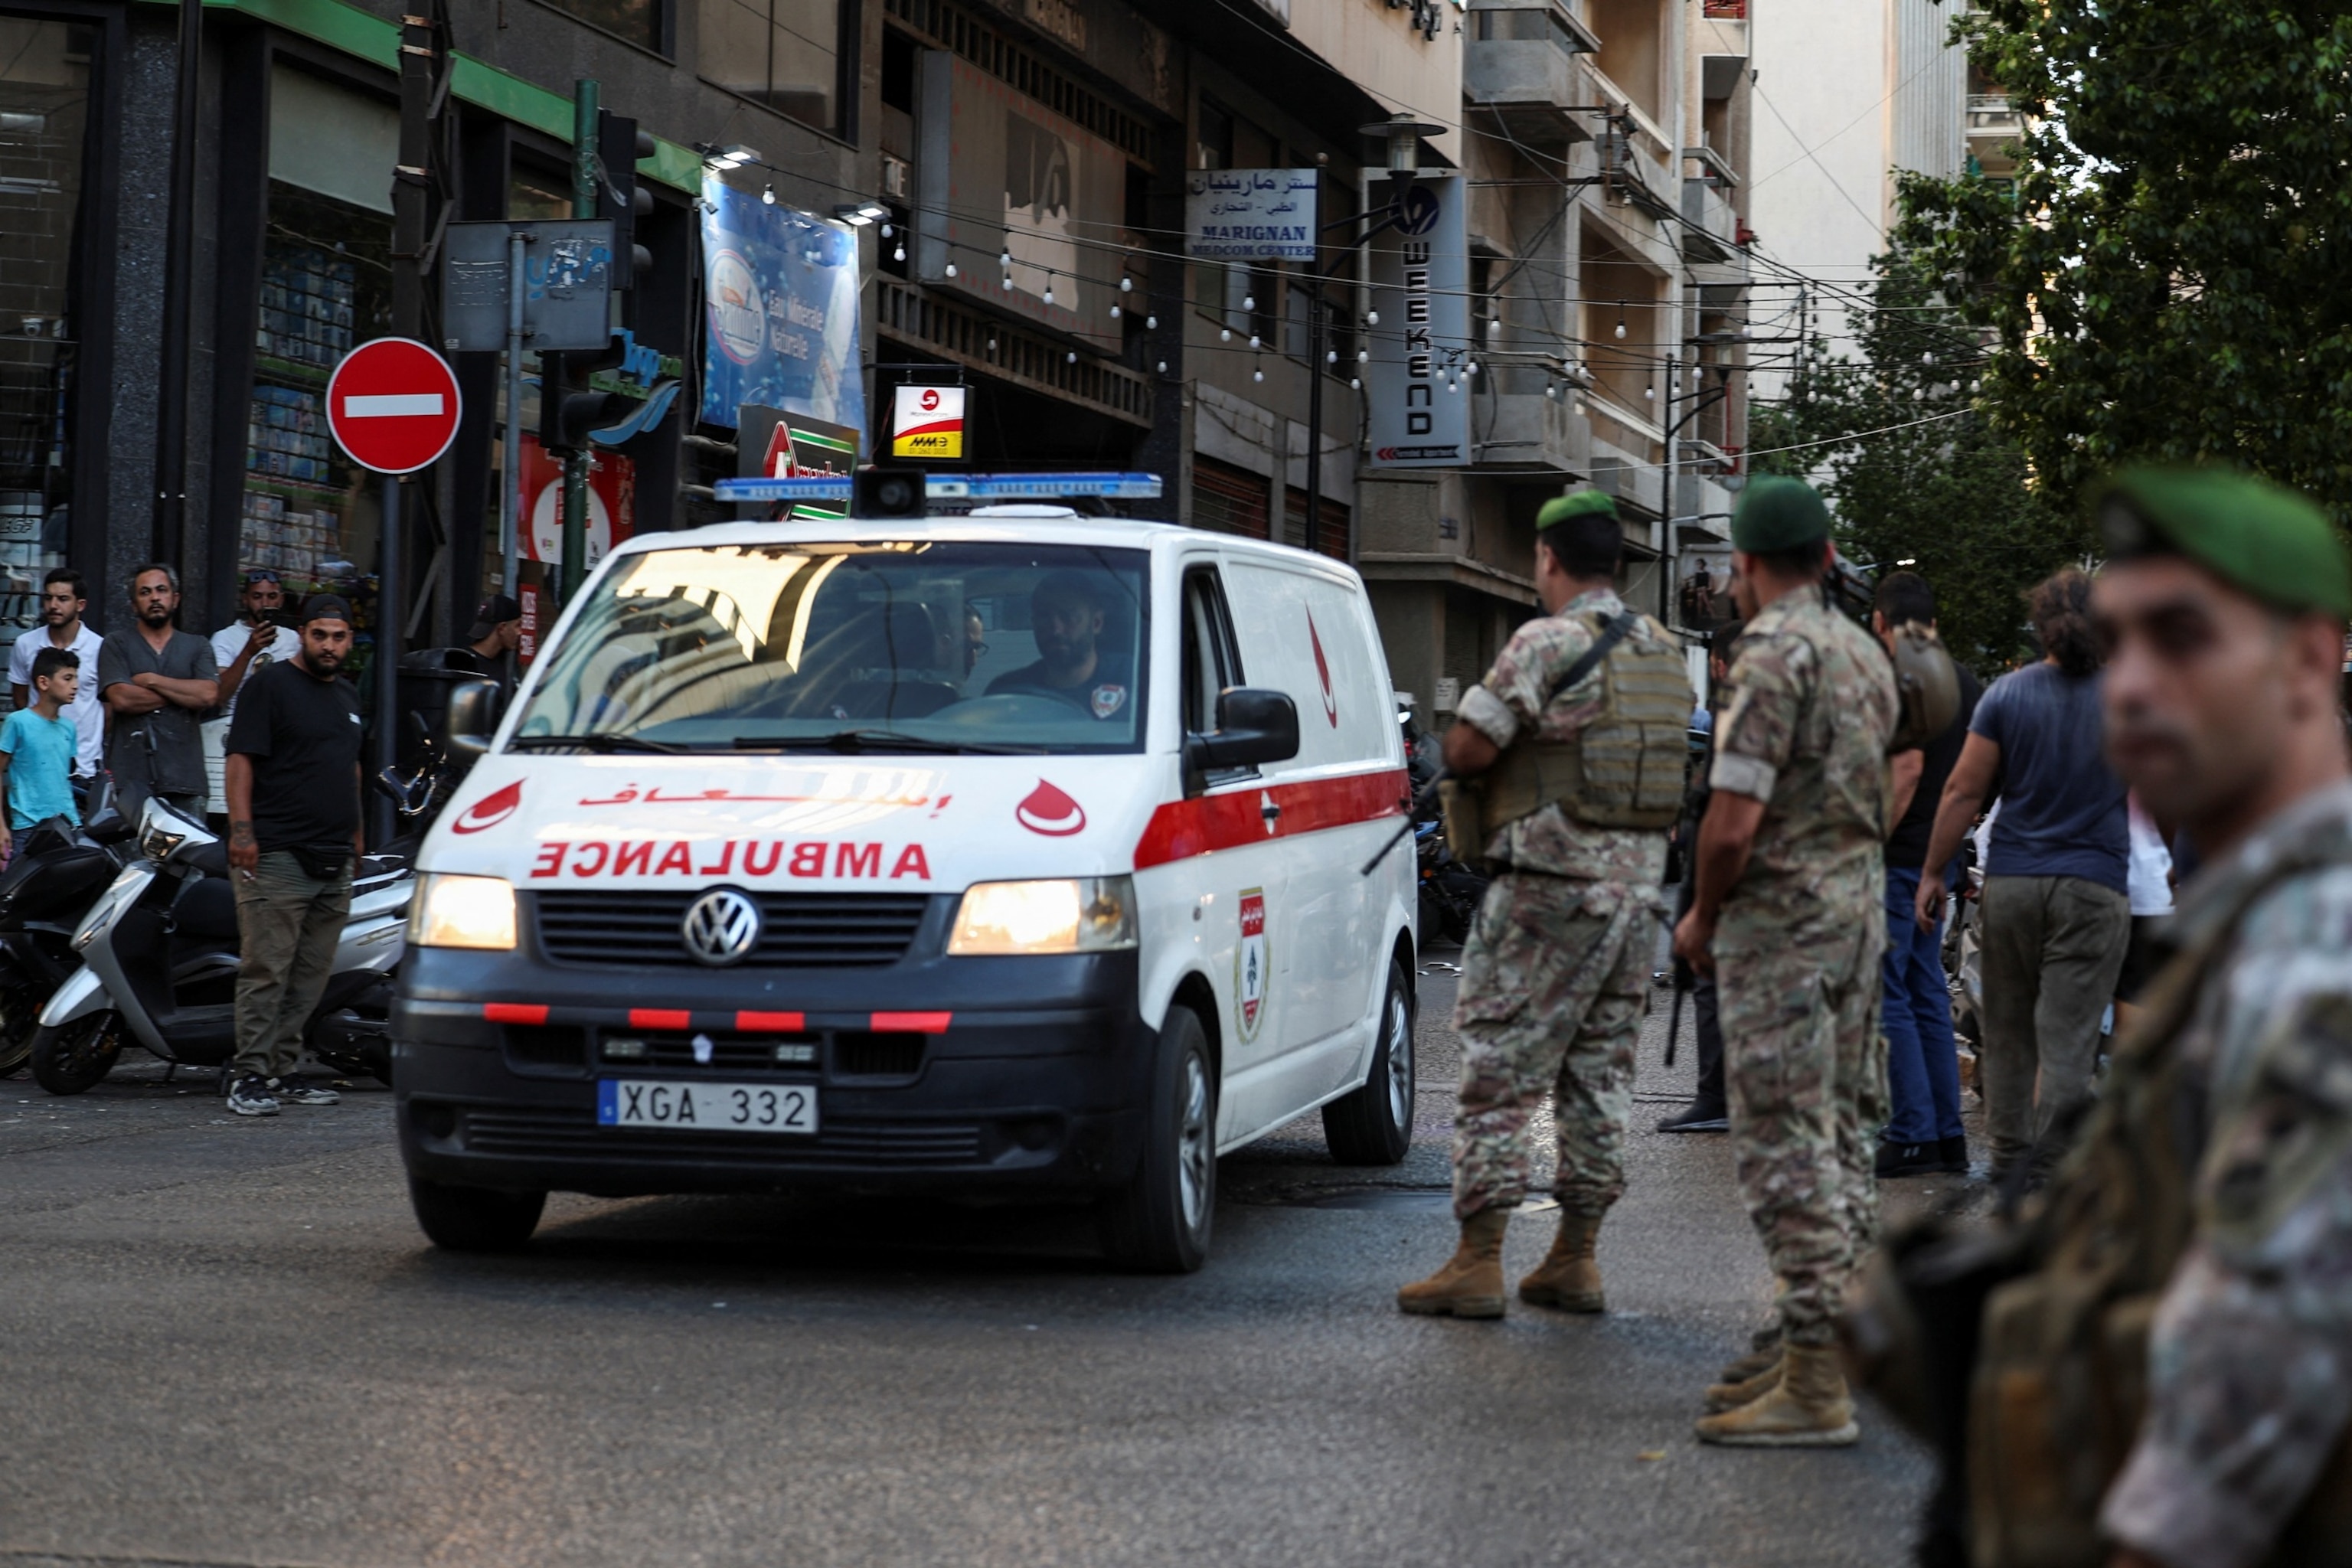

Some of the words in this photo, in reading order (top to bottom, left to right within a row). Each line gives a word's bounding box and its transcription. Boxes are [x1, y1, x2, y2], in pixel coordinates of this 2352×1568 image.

[1201, 226, 1307, 240] MARIGNAN
[1192, 245, 1254, 256] MEDCOM
[1257, 245, 1316, 256] CENTER
[624, 1085, 696, 1123] XGA
[730, 1089, 806, 1127] 332
